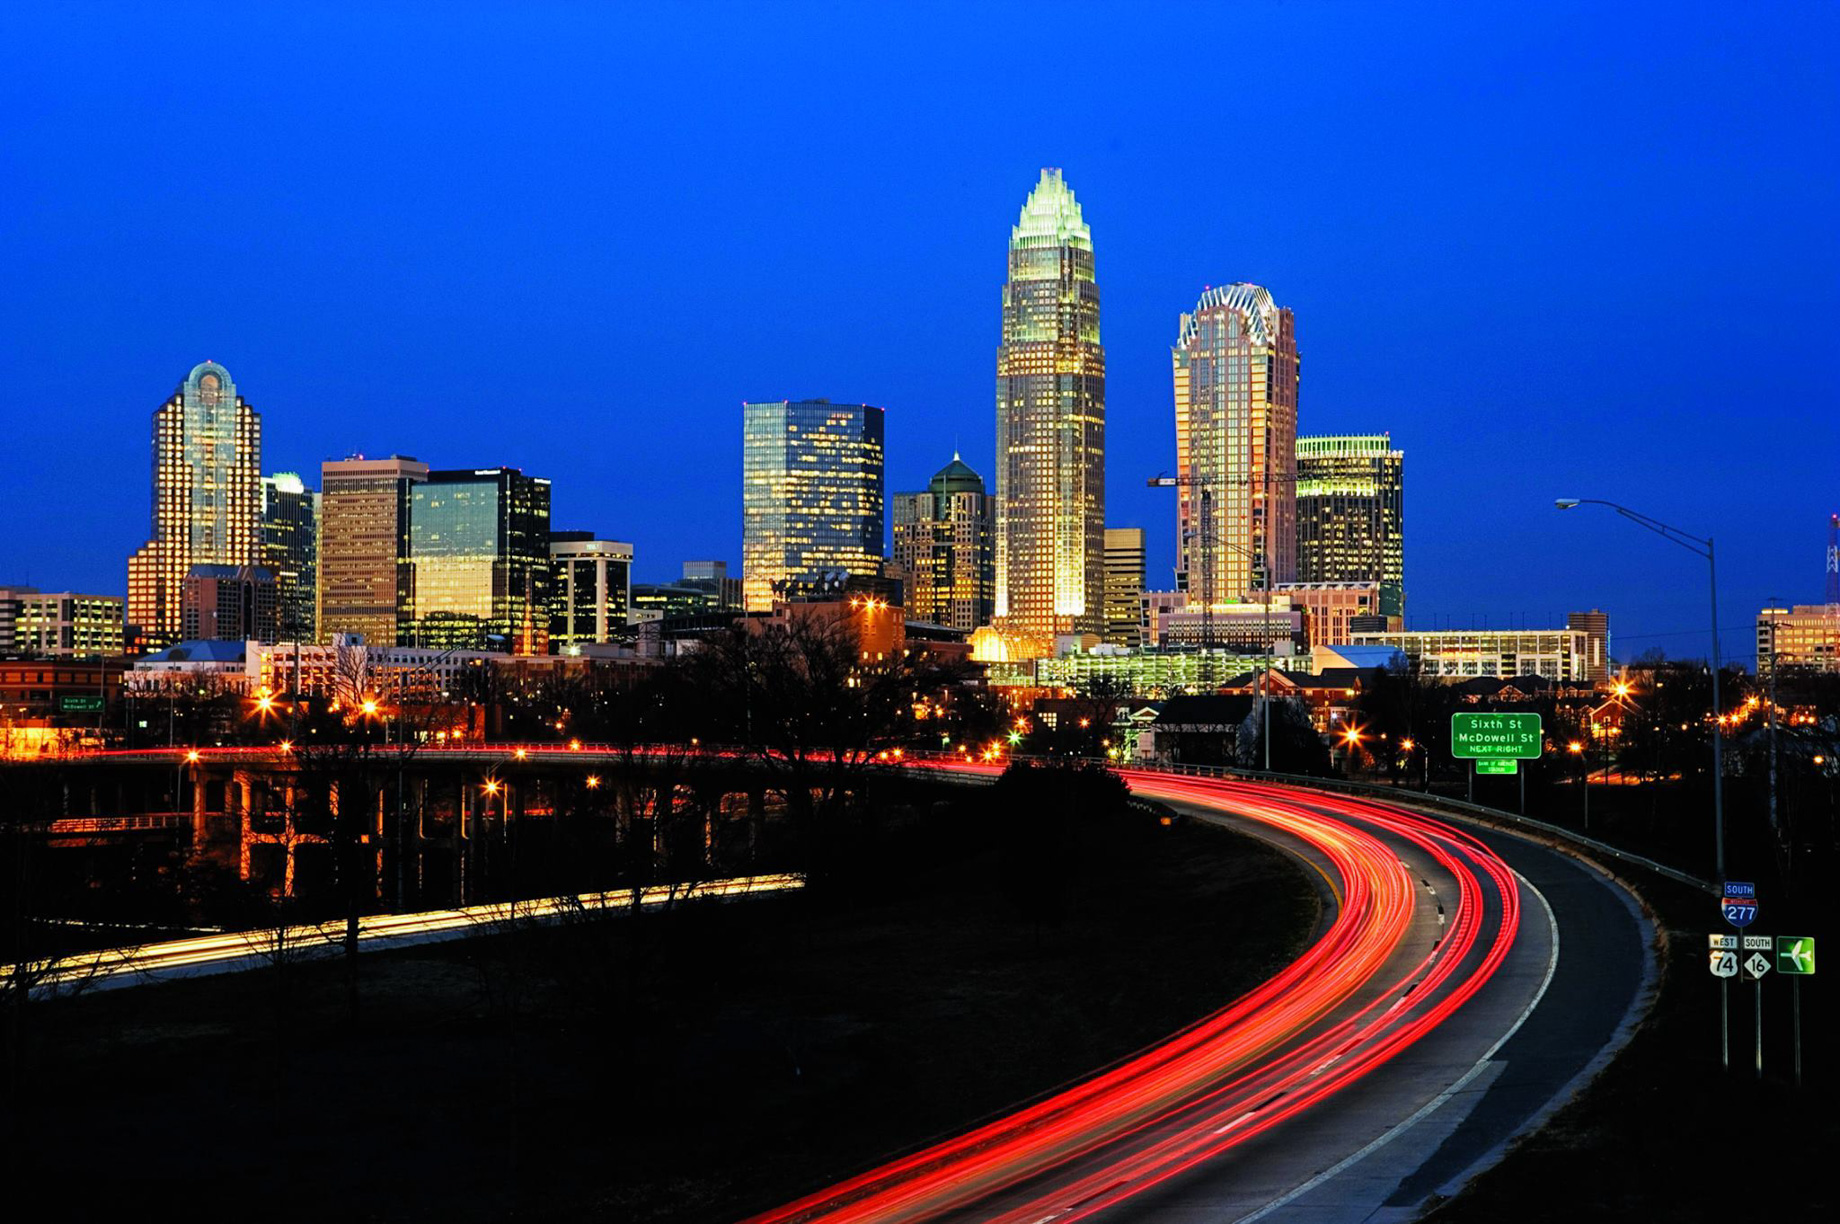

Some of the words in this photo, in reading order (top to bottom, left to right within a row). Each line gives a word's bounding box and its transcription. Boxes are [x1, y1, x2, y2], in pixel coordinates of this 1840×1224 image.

[1471, 719, 1503, 729] Sixth
[1509, 720, 1522, 729] St
[1459, 733, 1514, 742] McDowell
[1521, 733, 1533, 743] St
[1469, 745, 1492, 753] NEXT
[1496, 745, 1523, 753] RIGHT
[1726, 885, 1753, 894] SOUTH
[1728, 906, 1755, 920] 277
[1713, 938, 1734, 946] WEST
[1745, 938, 1770, 947] SOUTH
[1713, 956, 1734, 972] 74
[1751, 959, 1765, 972] 16
